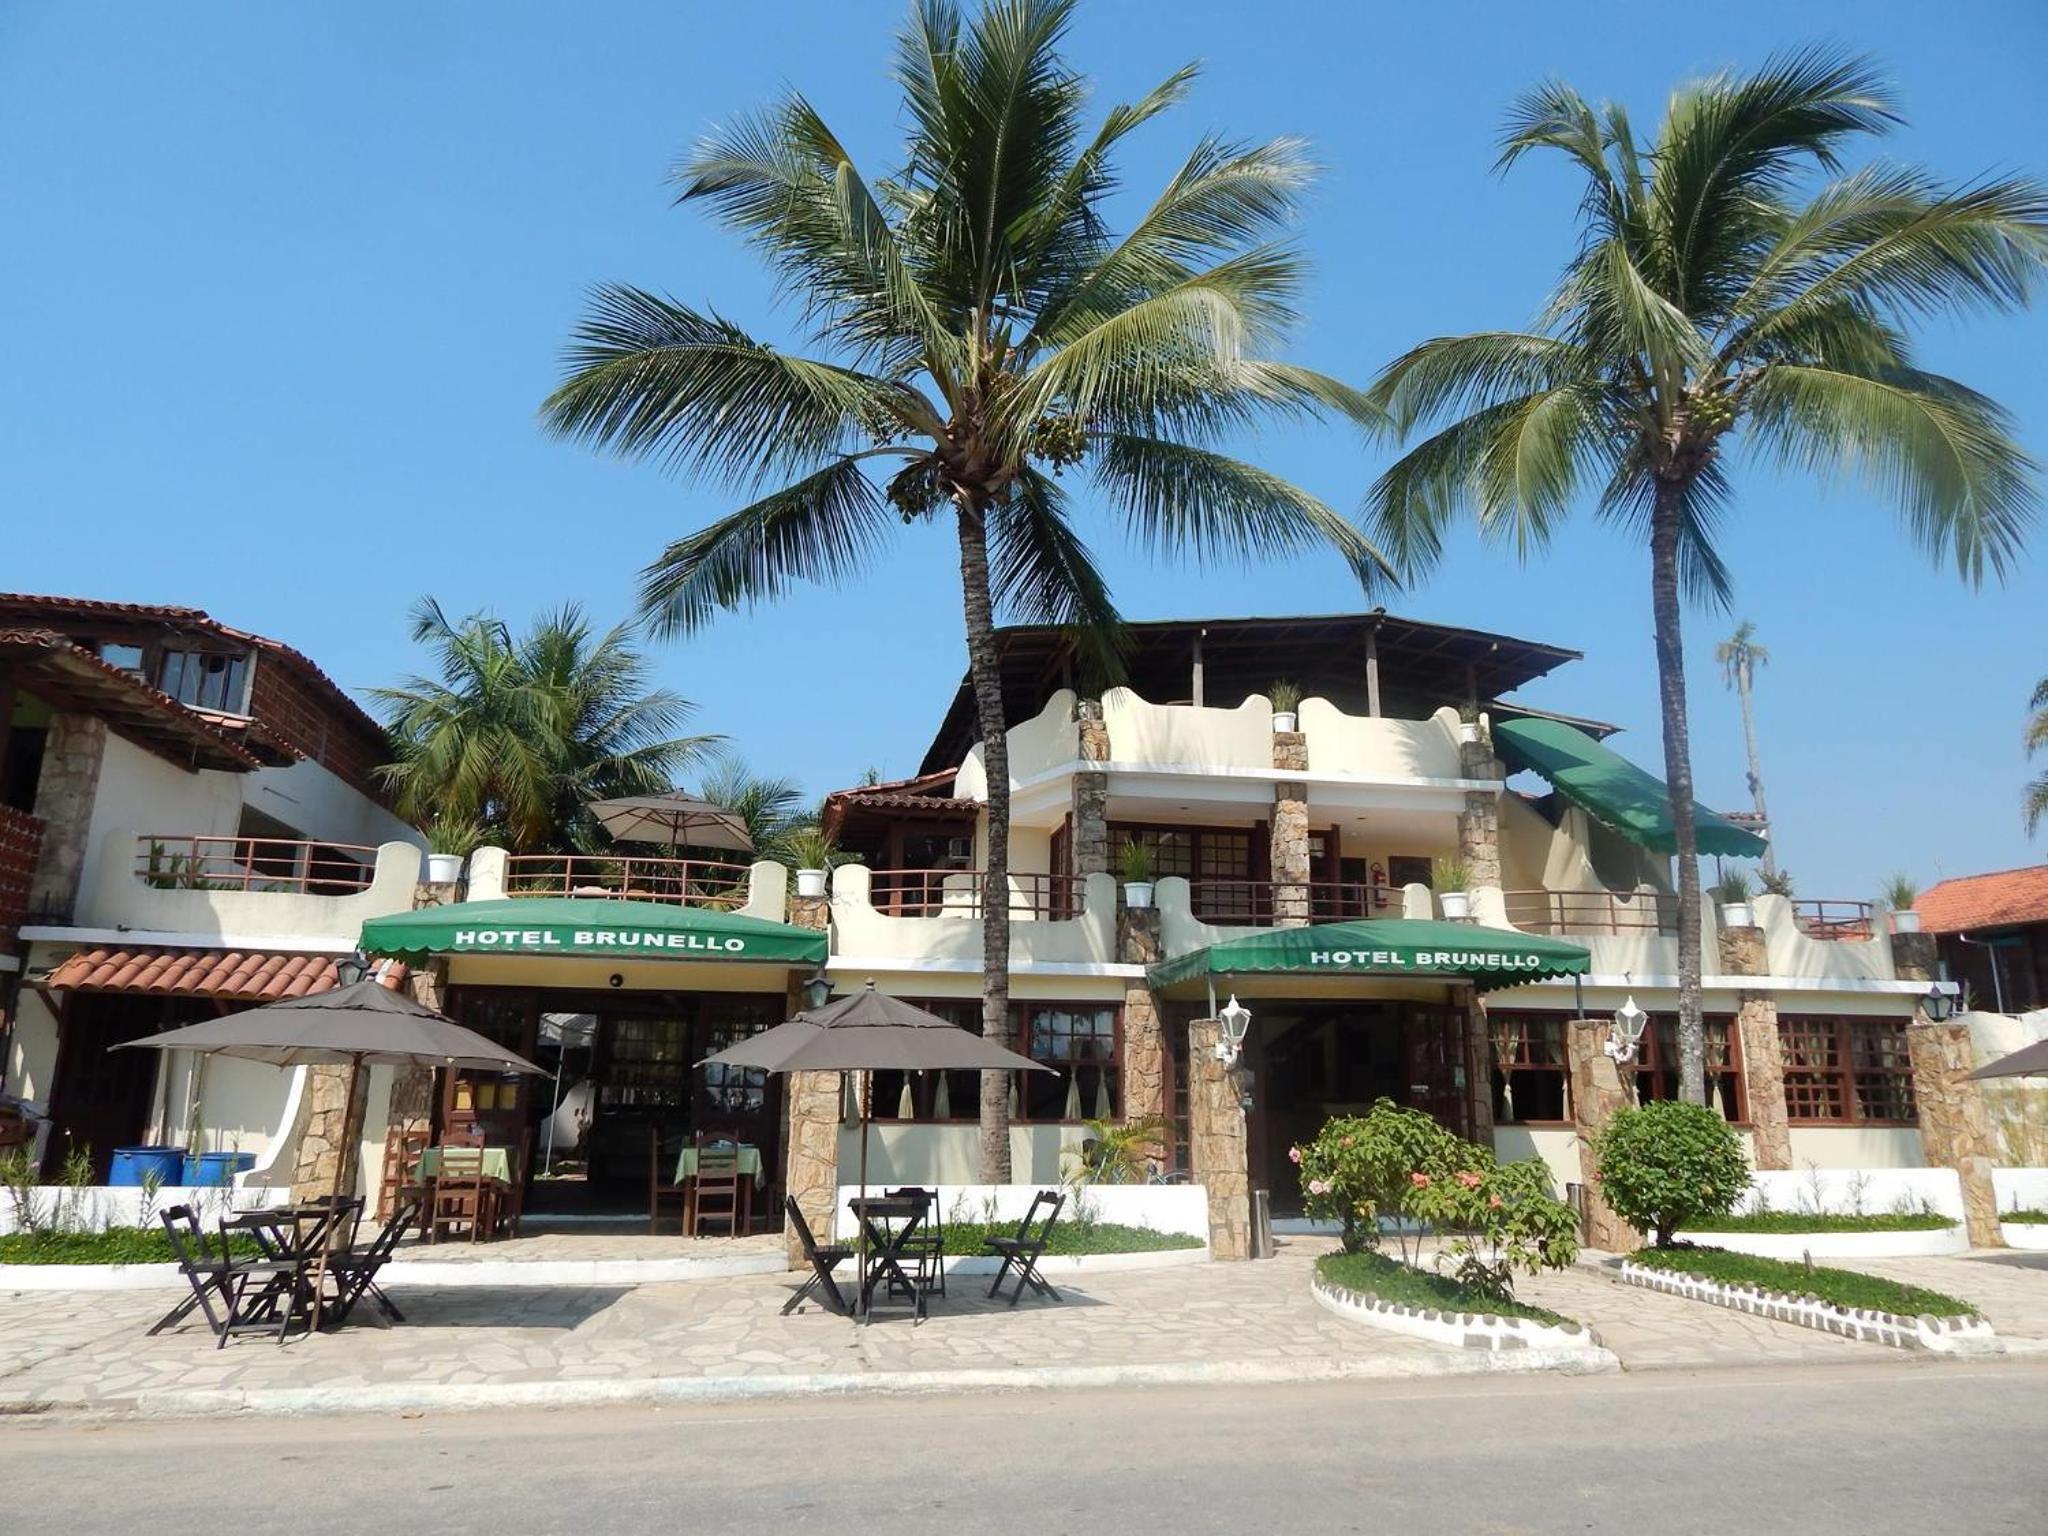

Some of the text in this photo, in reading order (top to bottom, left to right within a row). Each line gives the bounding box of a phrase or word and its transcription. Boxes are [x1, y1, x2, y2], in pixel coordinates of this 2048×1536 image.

[455, 930, 746, 952] HOTEL BRUNELLO
[1311, 951, 1541, 968] HOTEL BRUNELLO
